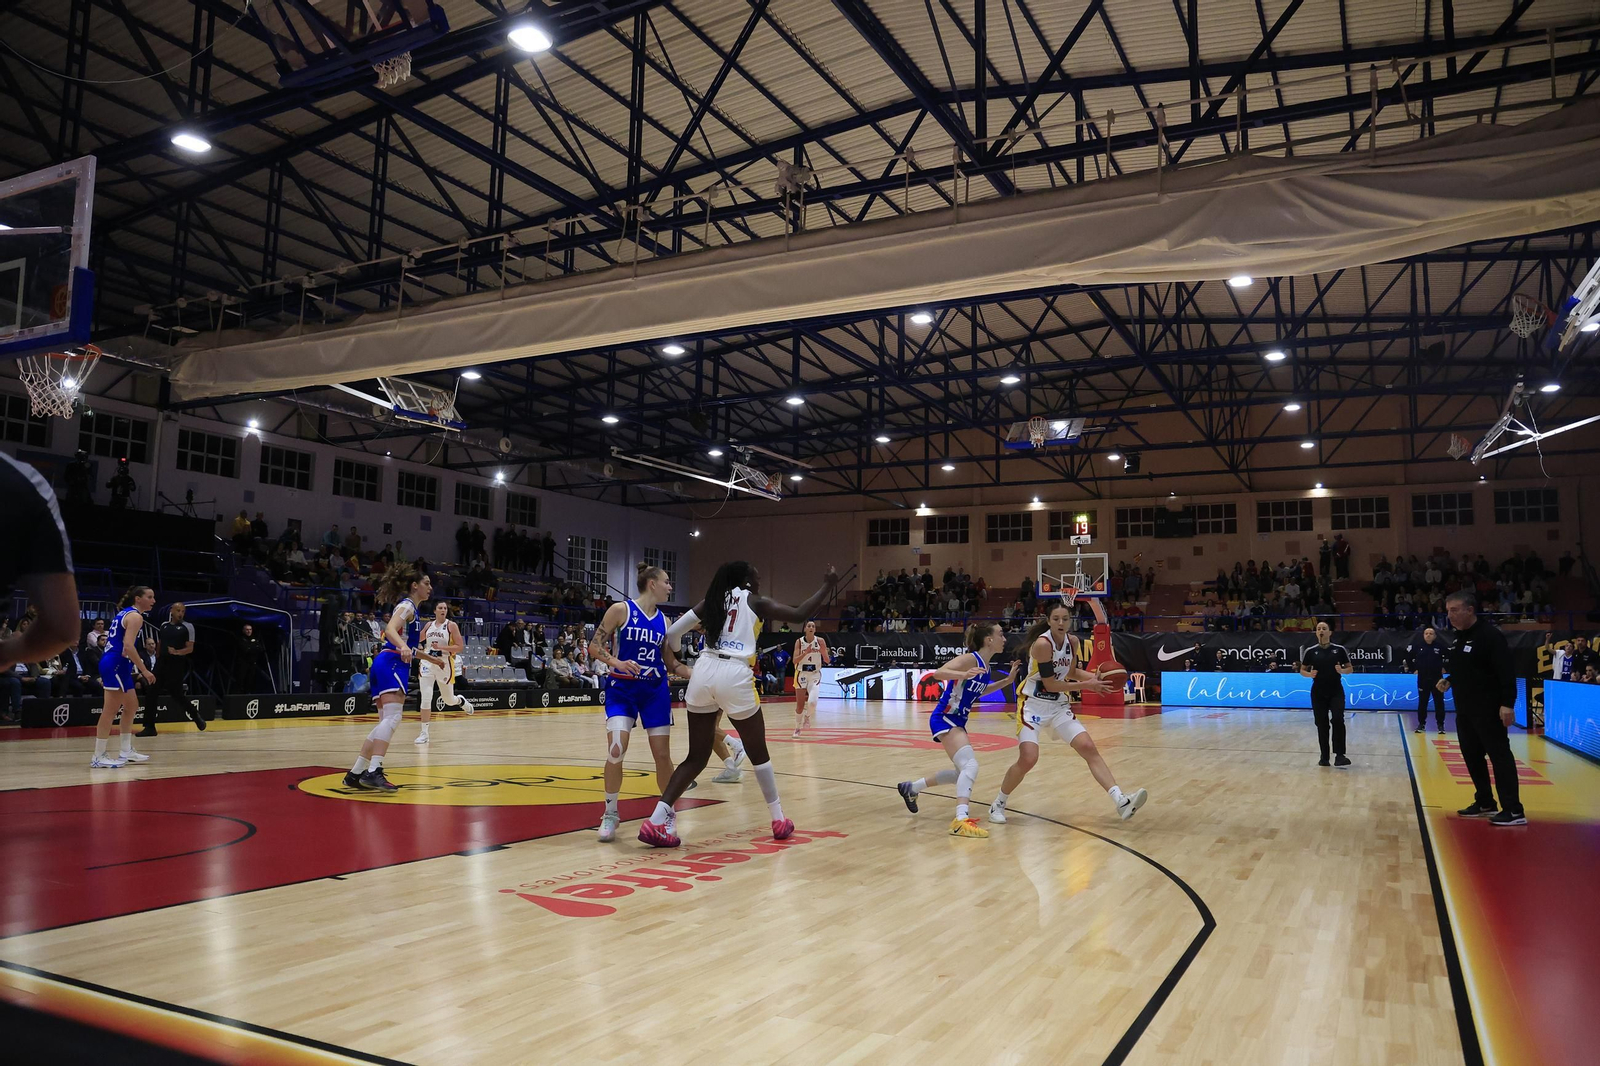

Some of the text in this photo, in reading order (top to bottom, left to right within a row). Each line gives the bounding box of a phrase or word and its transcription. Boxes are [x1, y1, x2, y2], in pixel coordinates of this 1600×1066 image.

[1076, 522, 1088, 534] 19
[637, 647, 656, 662] 24
[878, 648, 918, 658] aixaBank
[1221, 645, 1287, 661] endesa
[558, 694, 592, 704] #LaFamilia
[274, 701, 331, 714] #LaFamilia
[519, 850, 669, 881] emociones
